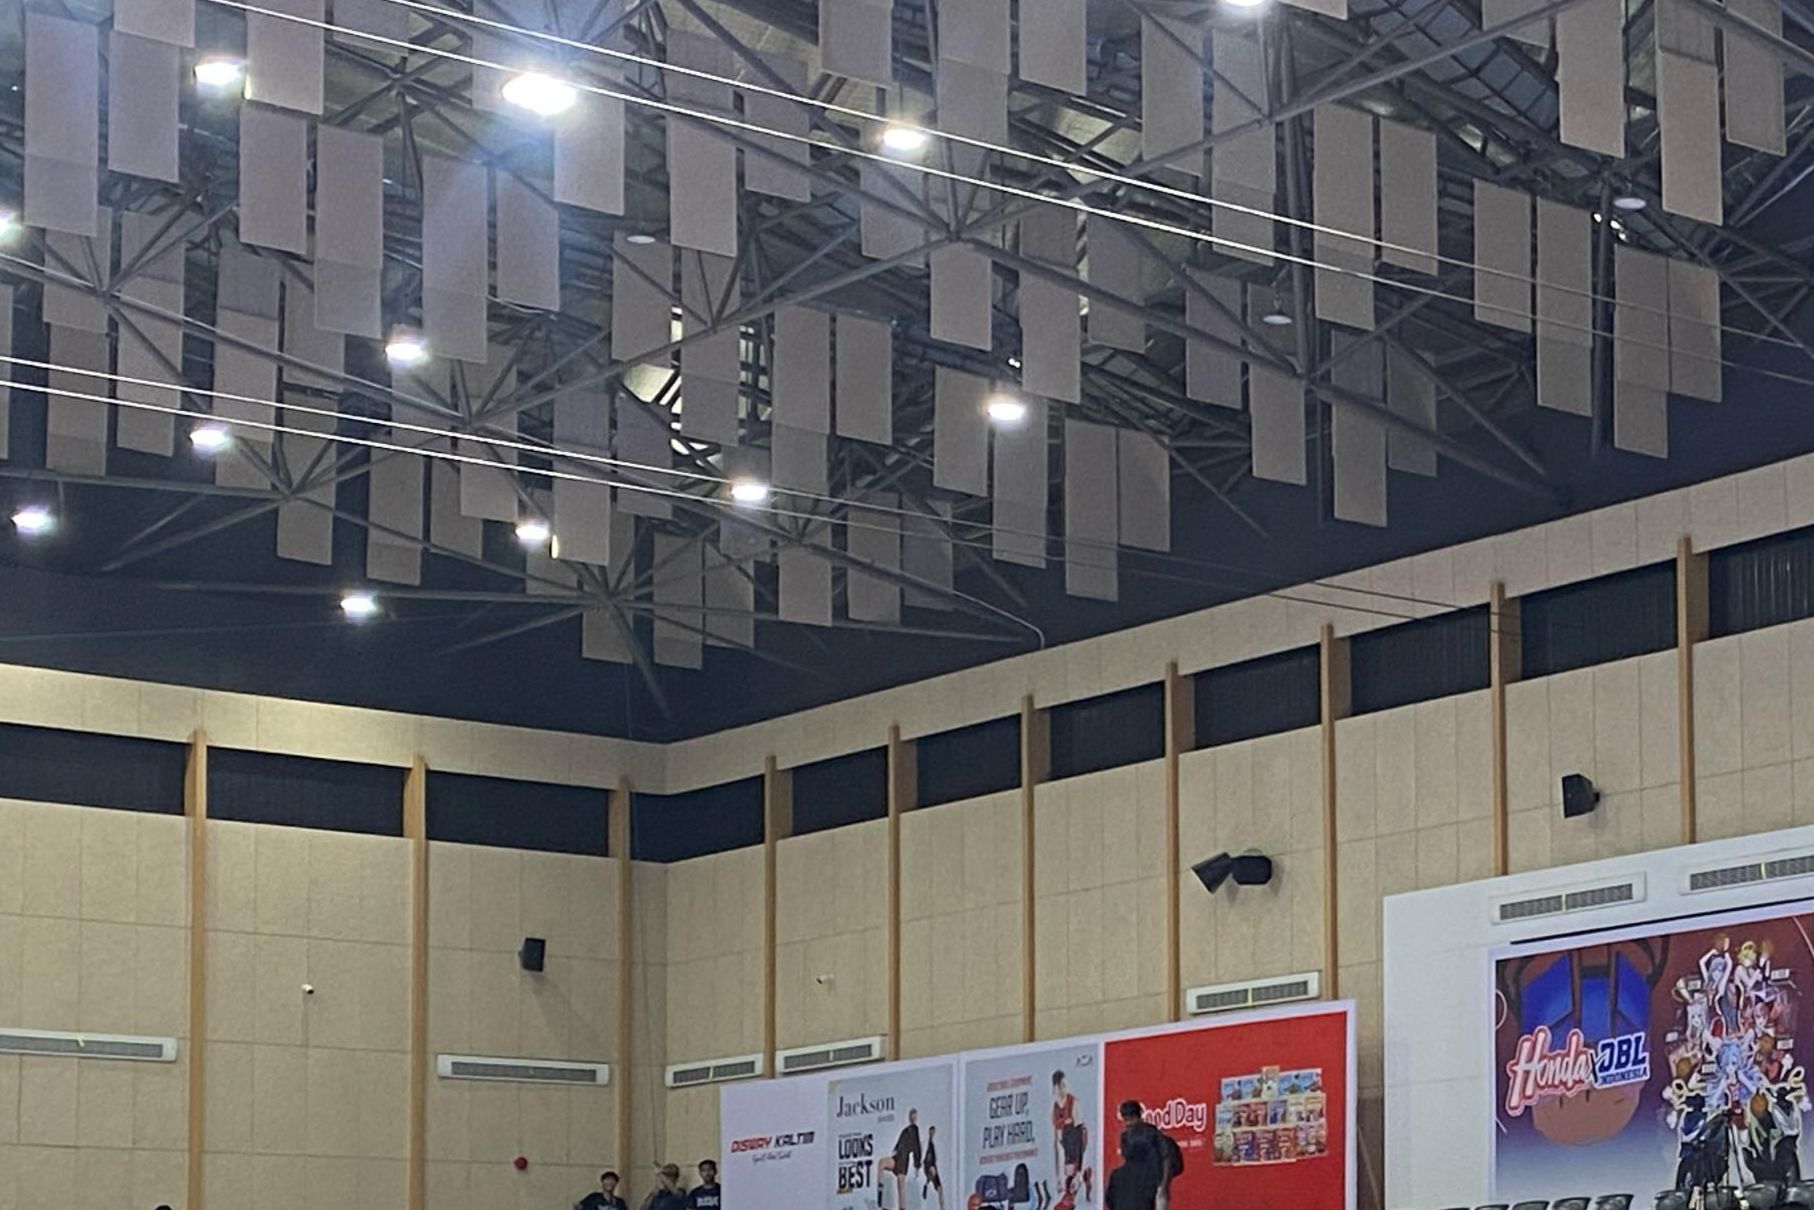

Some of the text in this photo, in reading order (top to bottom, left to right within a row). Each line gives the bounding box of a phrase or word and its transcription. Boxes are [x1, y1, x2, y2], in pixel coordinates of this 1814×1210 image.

[1507, 1026, 1592, 1112] Honda
[1600, 1034, 1647, 1074] DBL
[836, 1093, 895, 1118] Jackson
[838, 1133, 873, 1160] LOOKS
[982, 1124, 1006, 1149] PLAY
[838, 1159, 873, 1189] BEST
